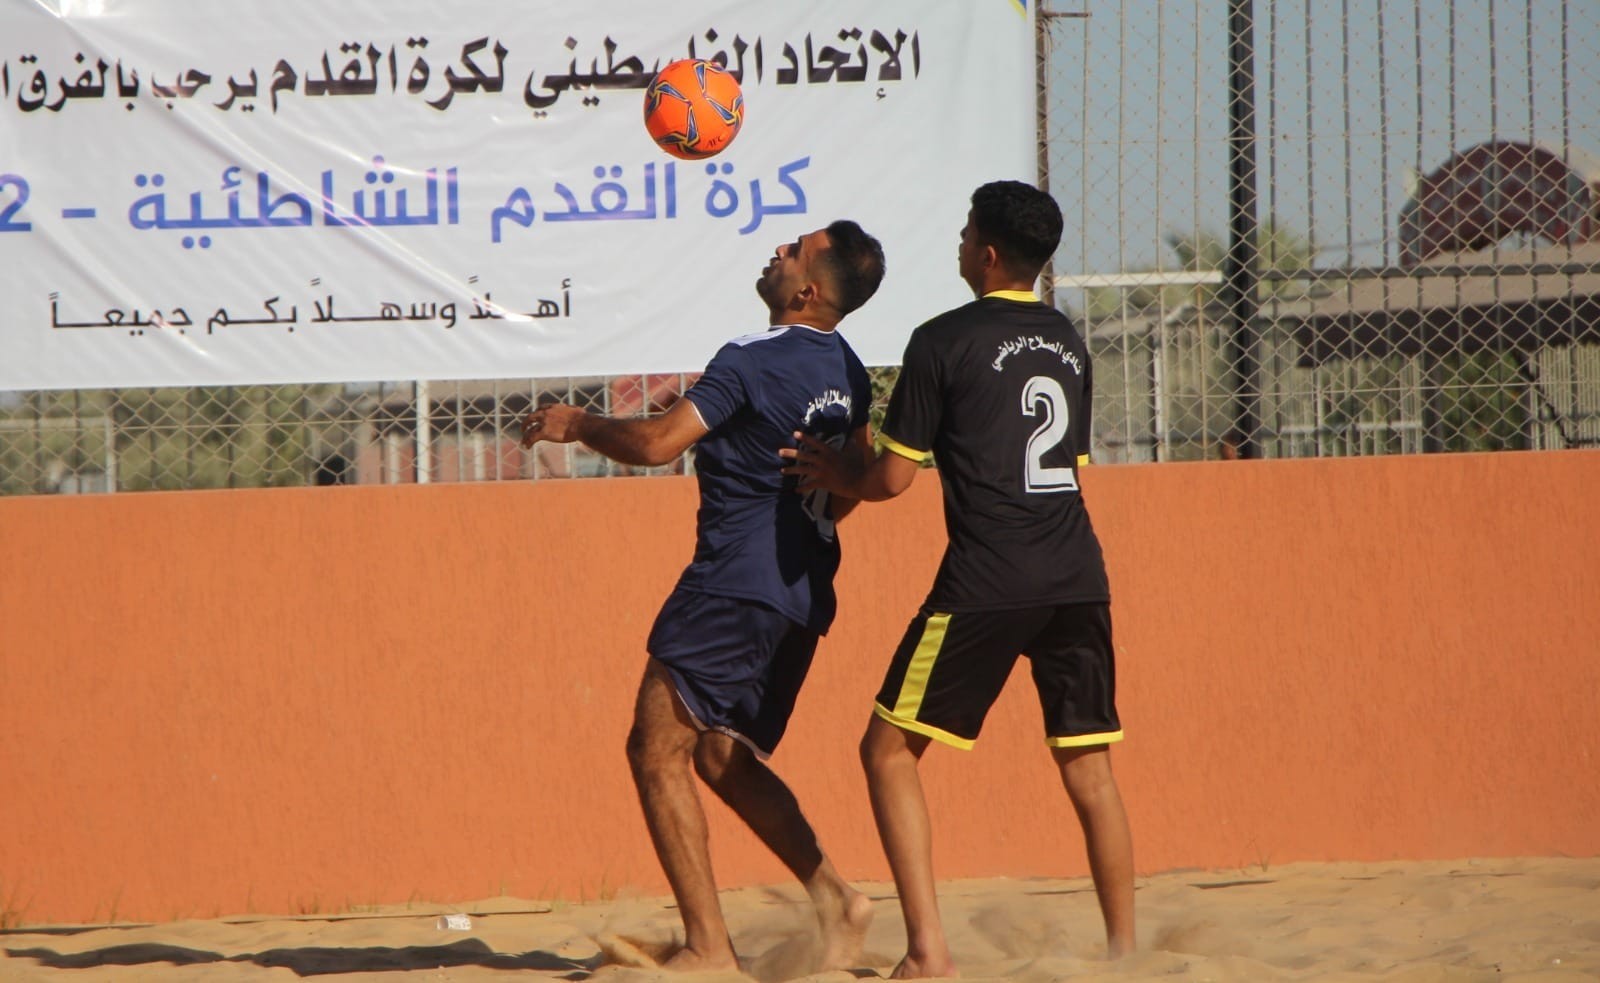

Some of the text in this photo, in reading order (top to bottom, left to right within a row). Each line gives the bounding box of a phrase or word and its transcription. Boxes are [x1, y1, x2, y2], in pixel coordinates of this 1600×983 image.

[17, 52, 140, 113] بالفرق
[152, 67, 258, 112] يرحب
[271, 42, 398, 115] القدم
[406, 37, 510, 111] لكرة
[776, 27, 921, 102] الإتحاد
[128, 154, 461, 250] الشاطئية
[490, 160, 679, 244] القدم
[704, 155, 813, 236] كرة
[207, 295, 298, 336] بكم
[1021, 375, 1080, 493] 2
